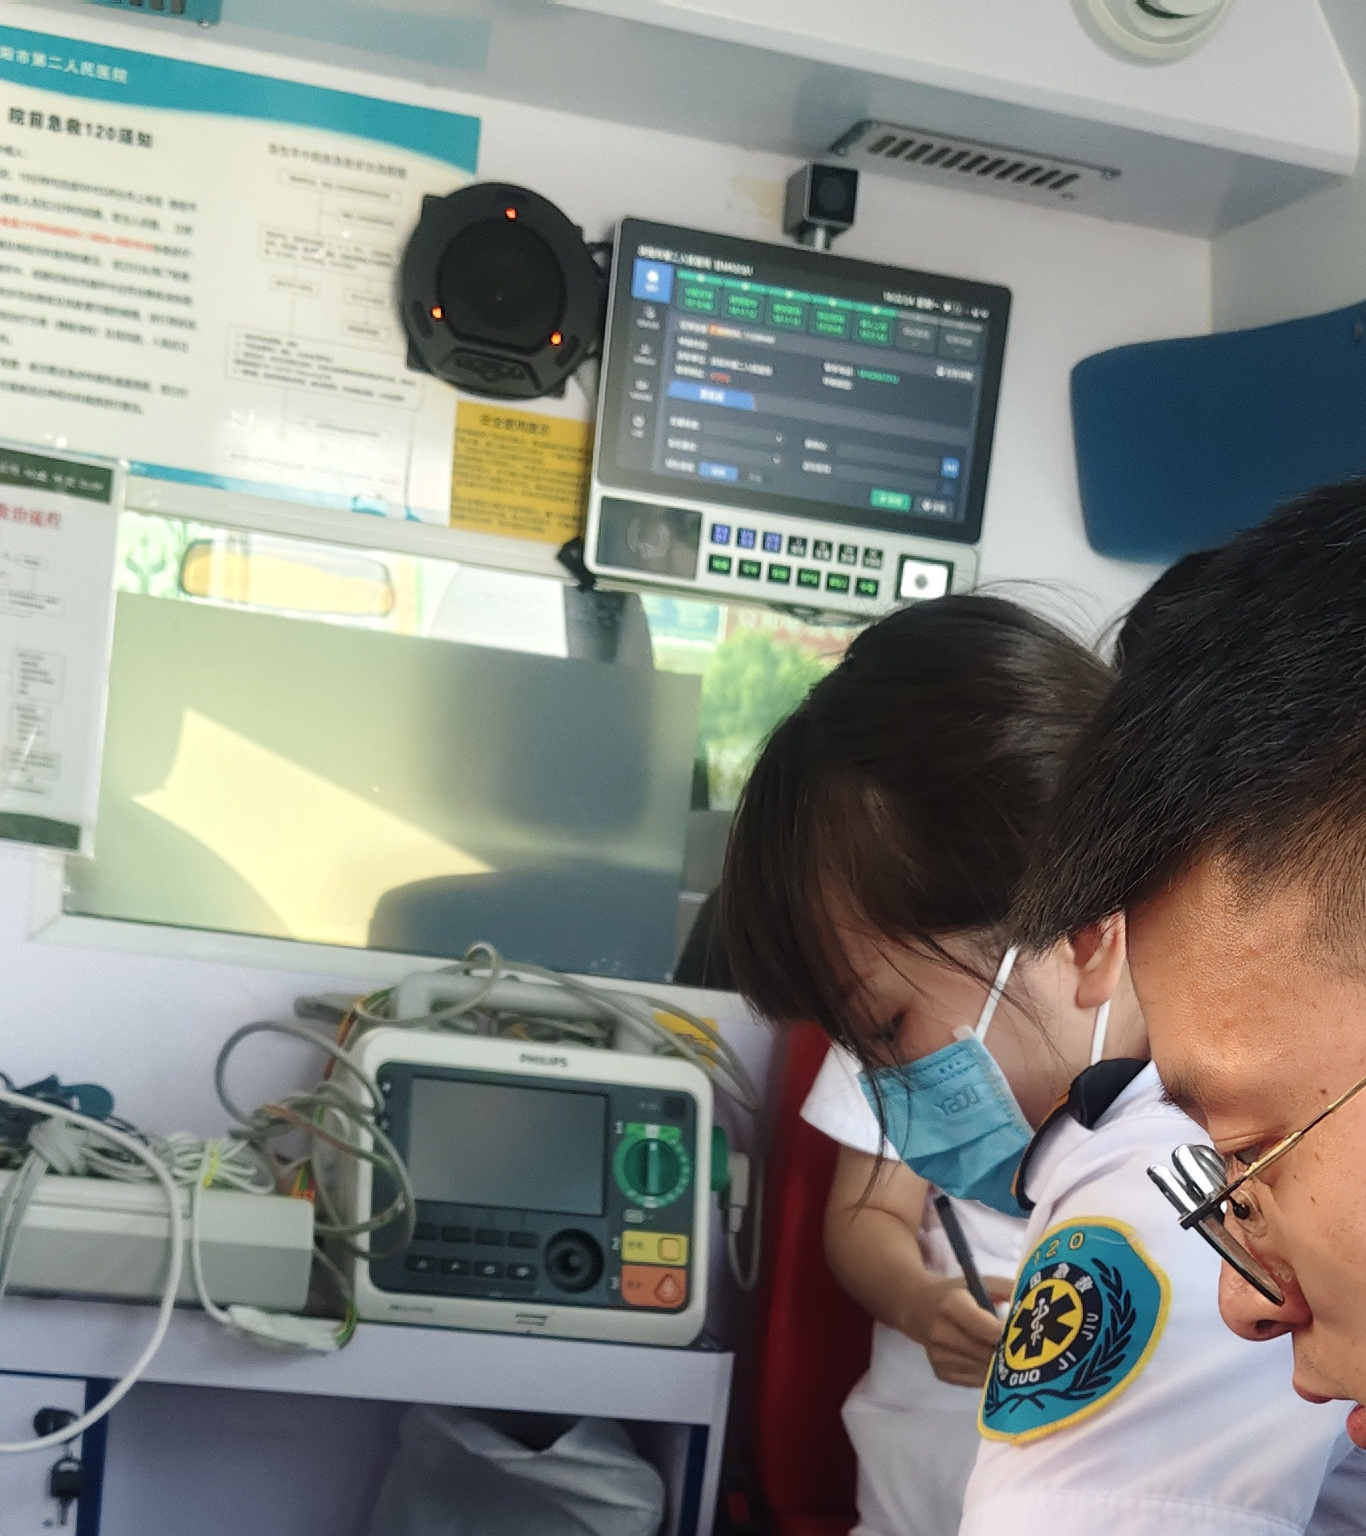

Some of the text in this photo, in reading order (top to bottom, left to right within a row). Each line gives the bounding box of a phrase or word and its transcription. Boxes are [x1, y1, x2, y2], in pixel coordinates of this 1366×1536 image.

[1033, 1231, 1084, 1264] 120
[1009, 1369, 1041, 1386] GUO
[1058, 1350, 1077, 1371] JI
[1081, 1311, 1100, 1341] JIU
